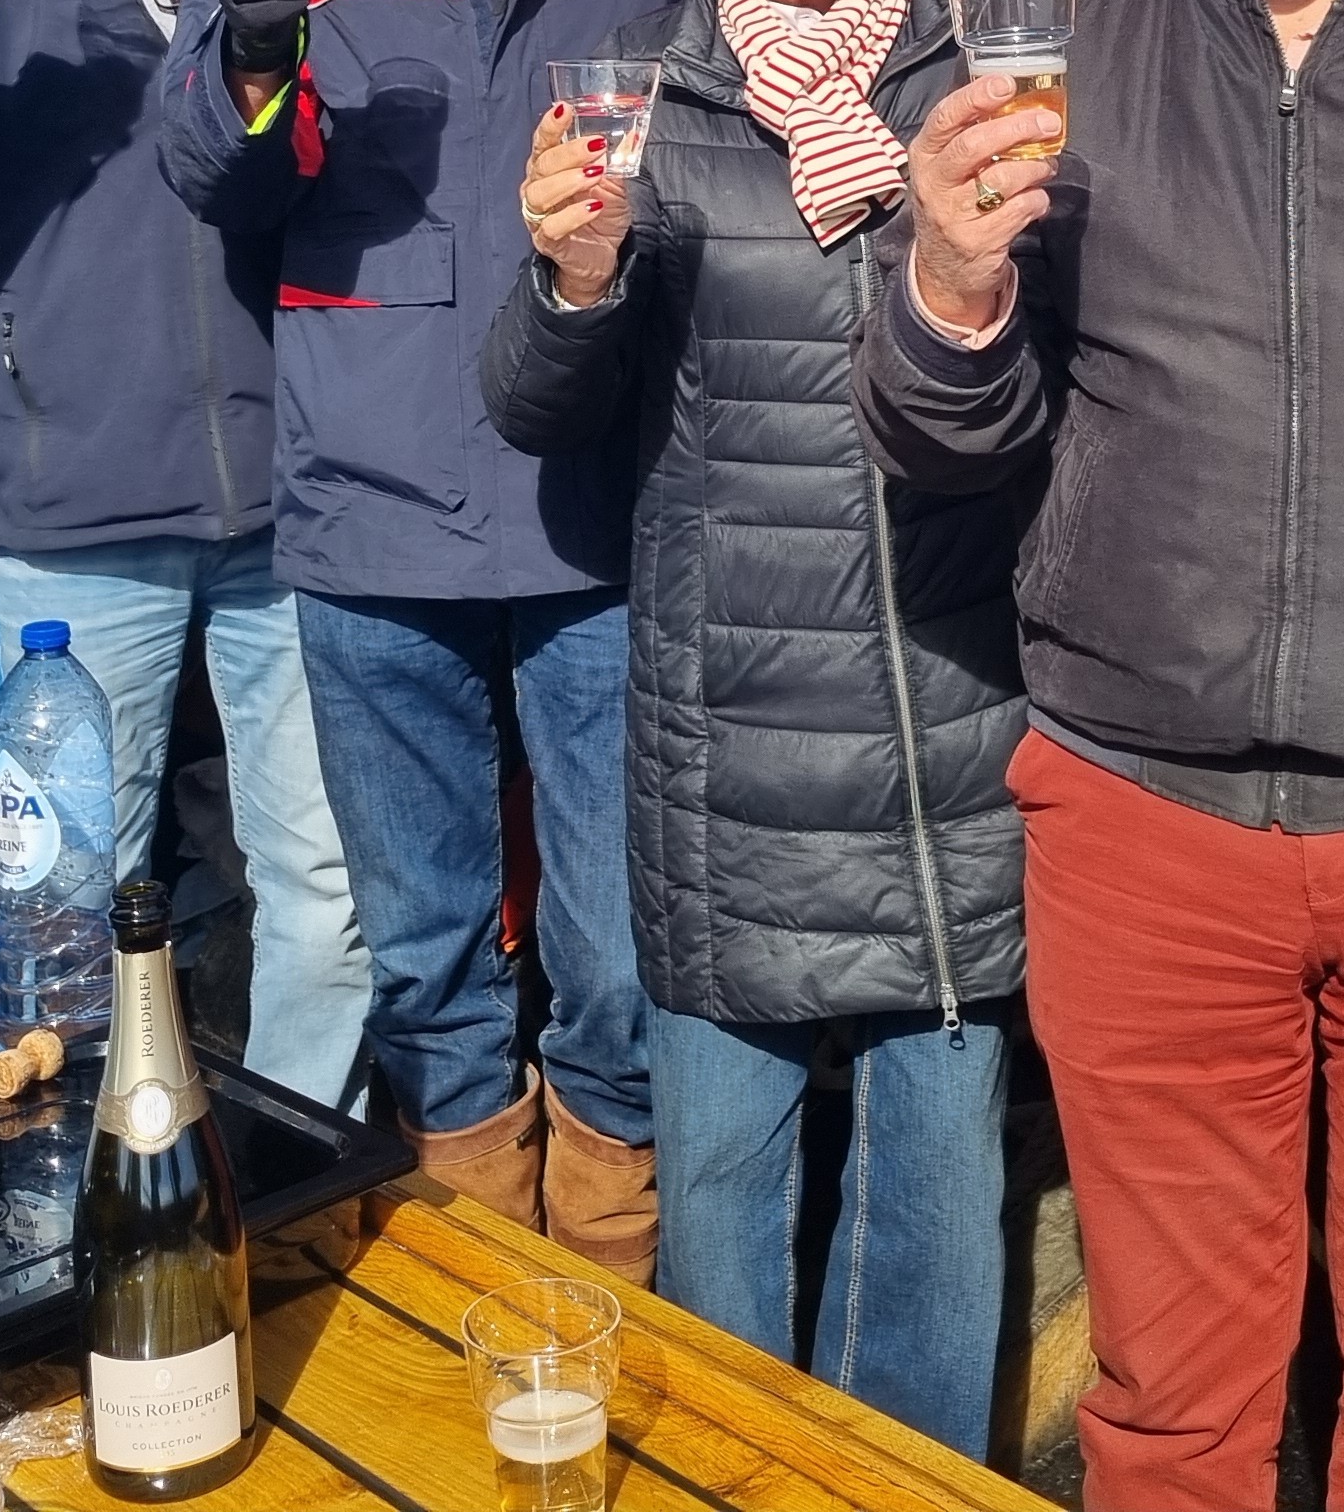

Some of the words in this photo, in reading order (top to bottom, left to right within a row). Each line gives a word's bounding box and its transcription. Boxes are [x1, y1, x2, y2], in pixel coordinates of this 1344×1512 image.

[140, 970, 154, 1059] ROEDERER
[99, 1397, 141, 1418] LOUIS
[146, 1382, 232, 1418] ROEDERER
[131, 1433, 202, 1451] COLLECTION
